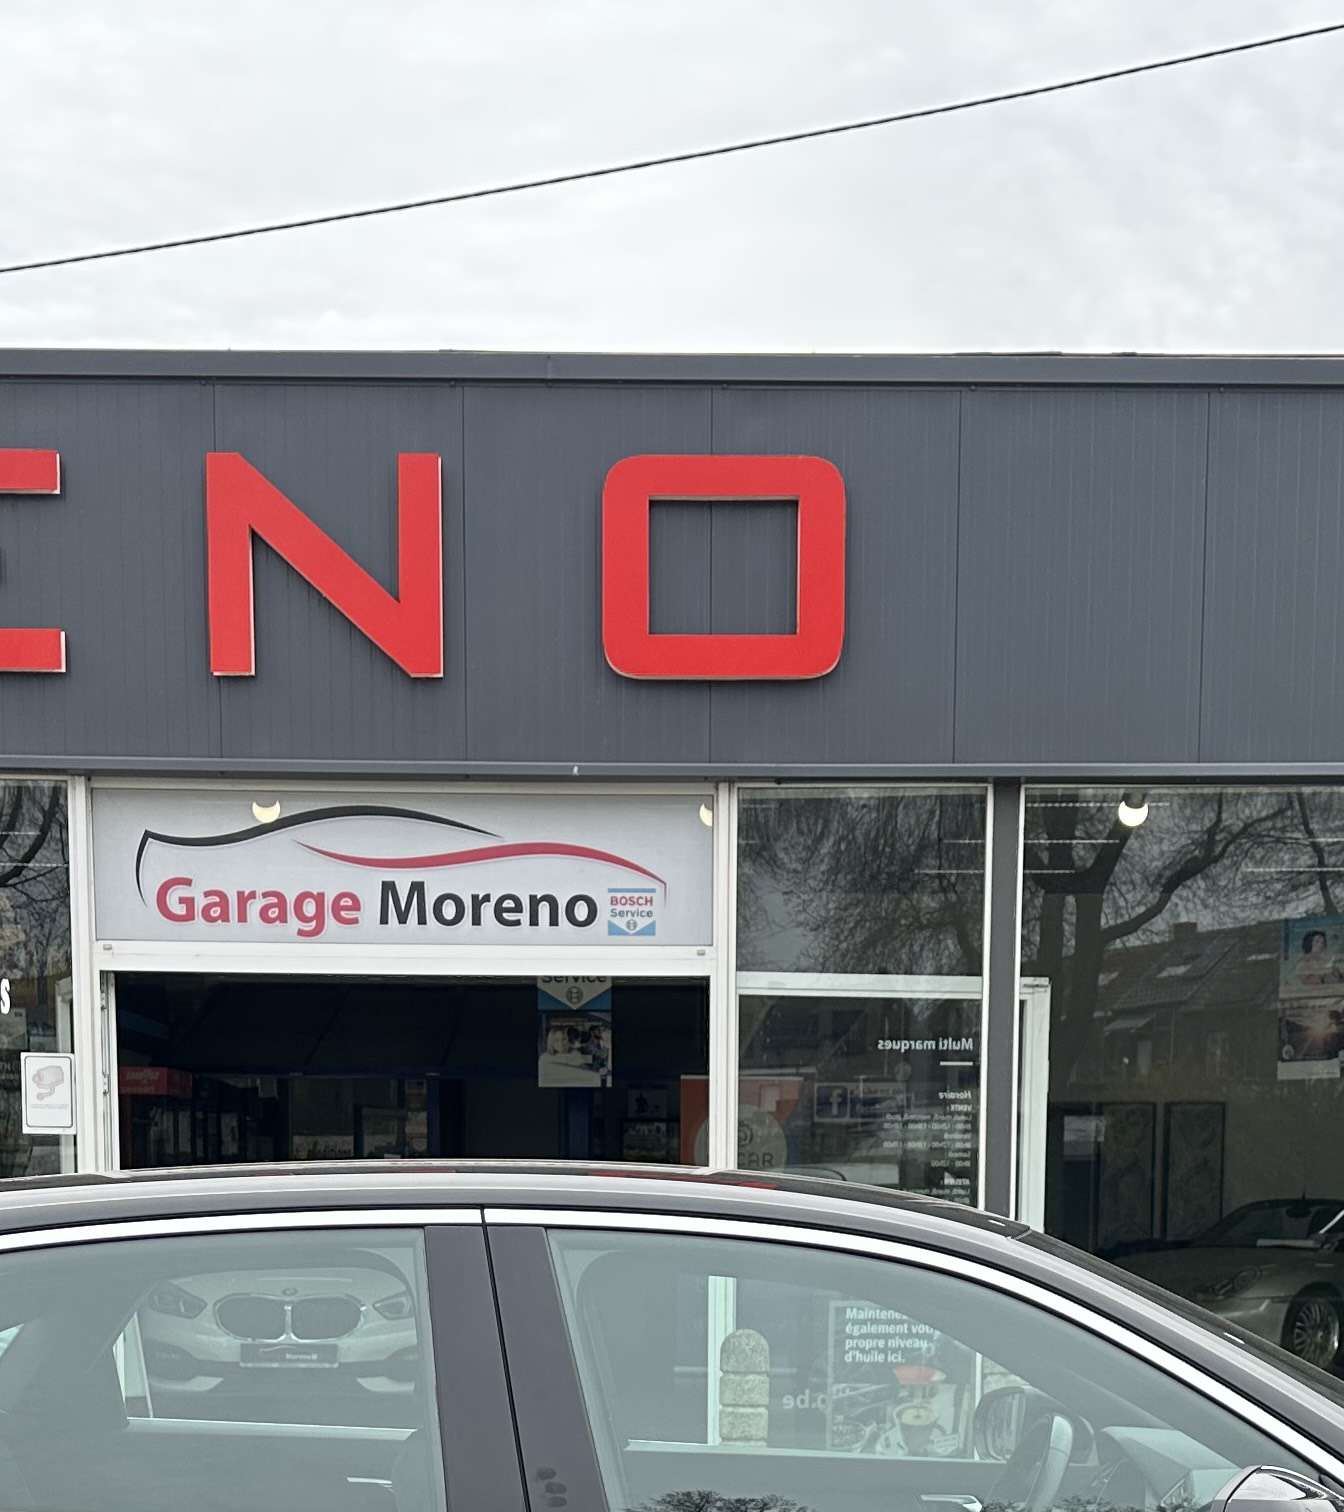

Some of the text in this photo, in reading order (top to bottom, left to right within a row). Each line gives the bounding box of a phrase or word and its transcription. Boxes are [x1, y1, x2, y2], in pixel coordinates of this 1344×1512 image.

[157, 876, 599, 937] Garage Moreno
[610, 895, 654, 907] BOSCH
[609, 907, 654, 918] Service
[845, 1323, 908, 1336] également
[845, 1336, 928, 1350] propre niveau
[844, 1351, 885, 1363] d'huile
